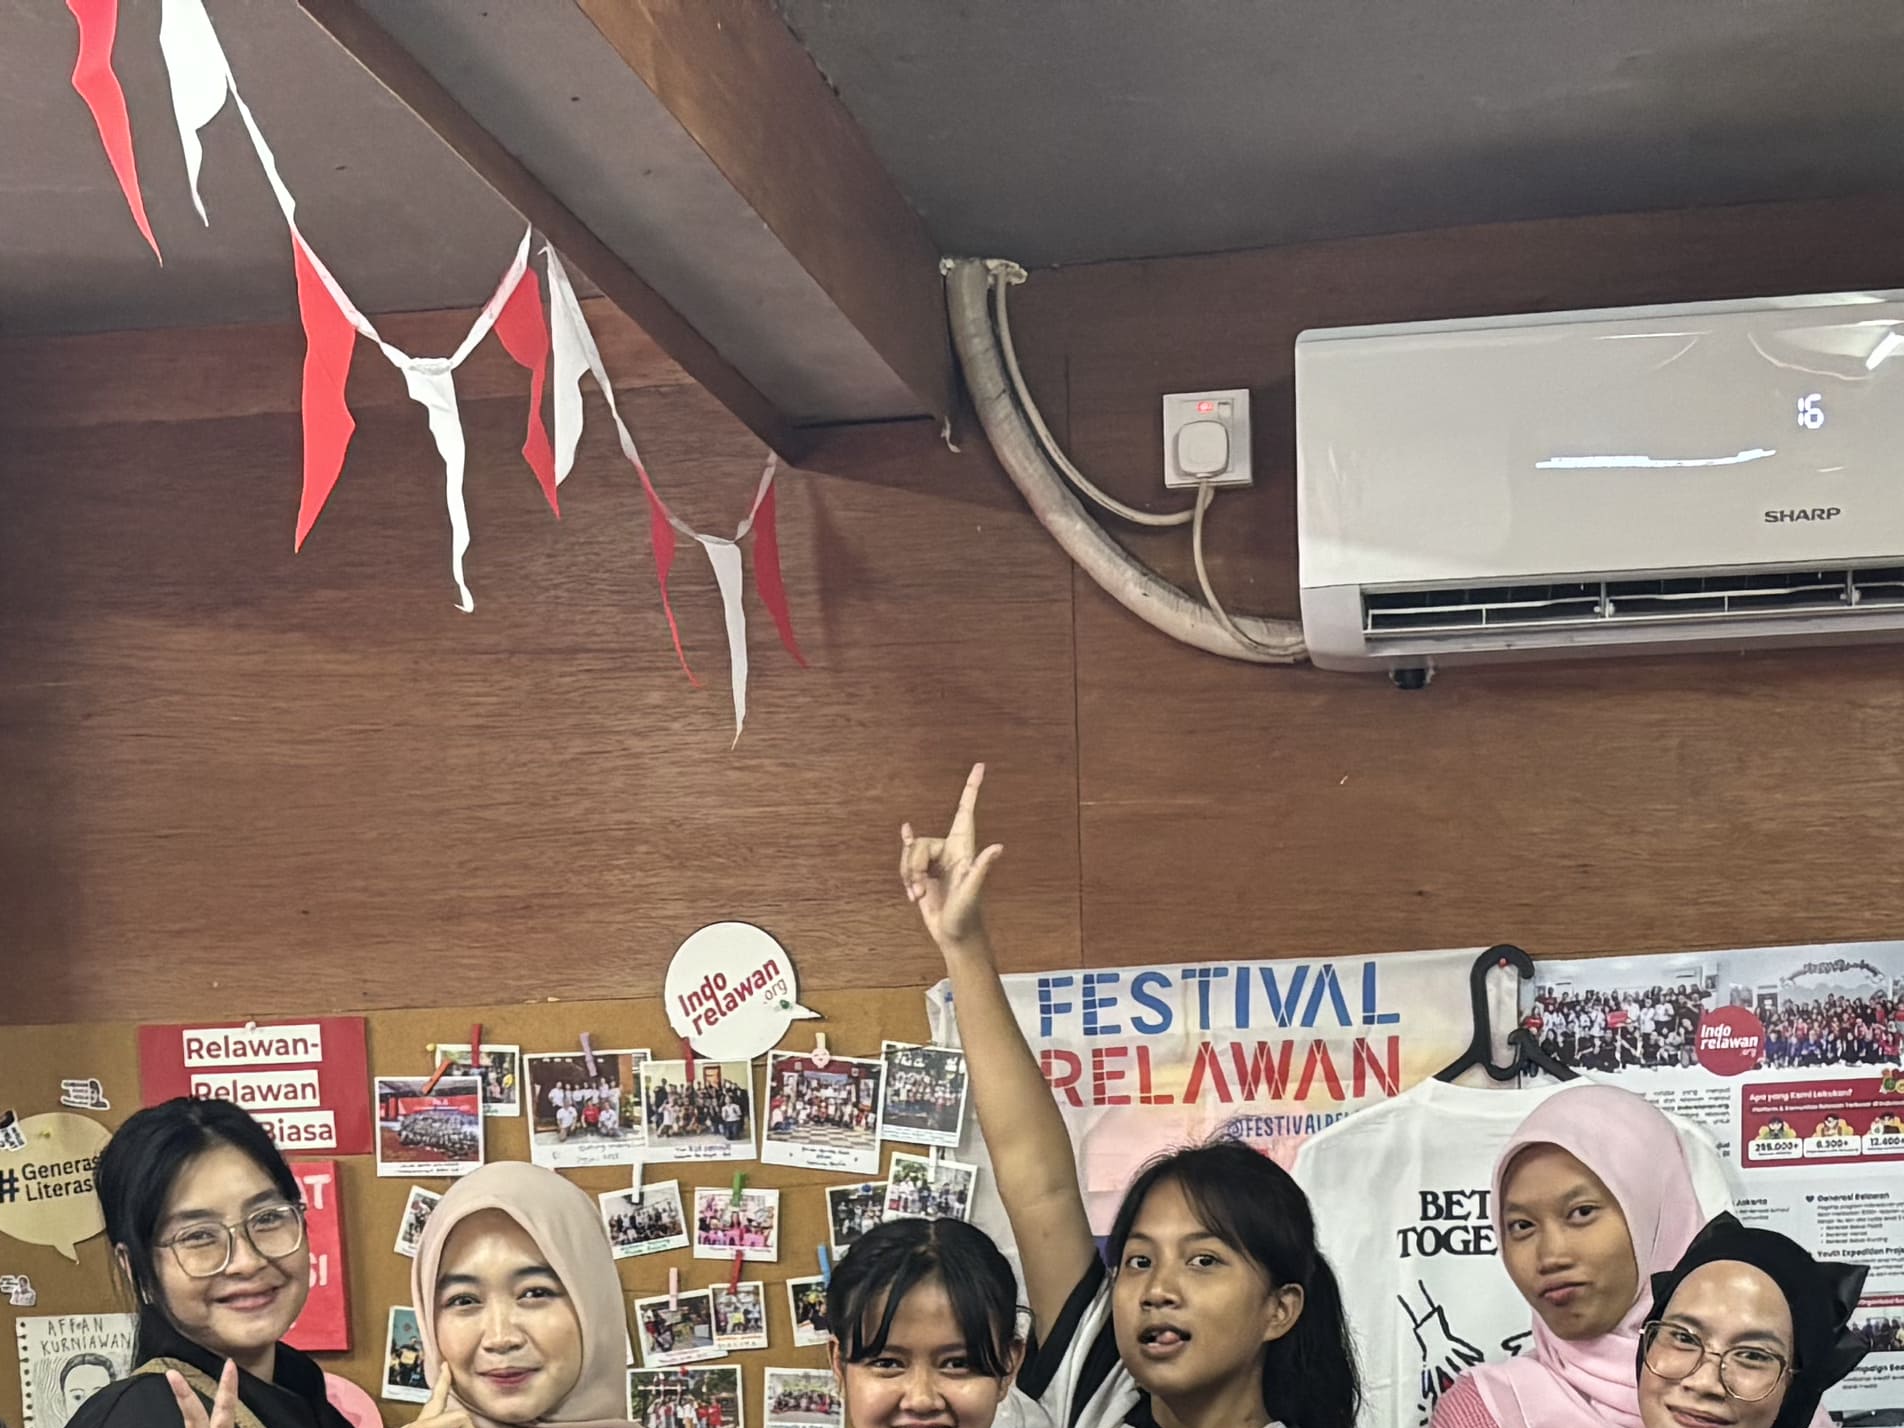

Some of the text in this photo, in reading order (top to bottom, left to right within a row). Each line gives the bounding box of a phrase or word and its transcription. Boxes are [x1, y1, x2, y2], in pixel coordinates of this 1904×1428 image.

[1797, 393, 1825, 430] 16
[1764, 507, 1840, 523] SHARP
[677, 971, 727, 1017] Indo
[691, 959, 781, 1036] relawan
[763, 978, 788, 1005] .org
[1037, 961, 1401, 1037] FESTIVAL
[1700, 1023, 1732, 1038] Indo
[1700, 1035, 1759, 1050] relawan
[186, 1035, 320, 1060] Relawan-
[1039, 1035, 1401, 1108] RELAWAN
[194, 1079, 318, 1104] Relawan
[22, 1155, 102, 1181] Generas
[25, 1177, 94, 1201] Literas
[1418, 1189, 1492, 1222] BET
[1397, 1224, 1499, 1259] TOGE
[40, 1332, 132, 1356] KURNIAWAN
